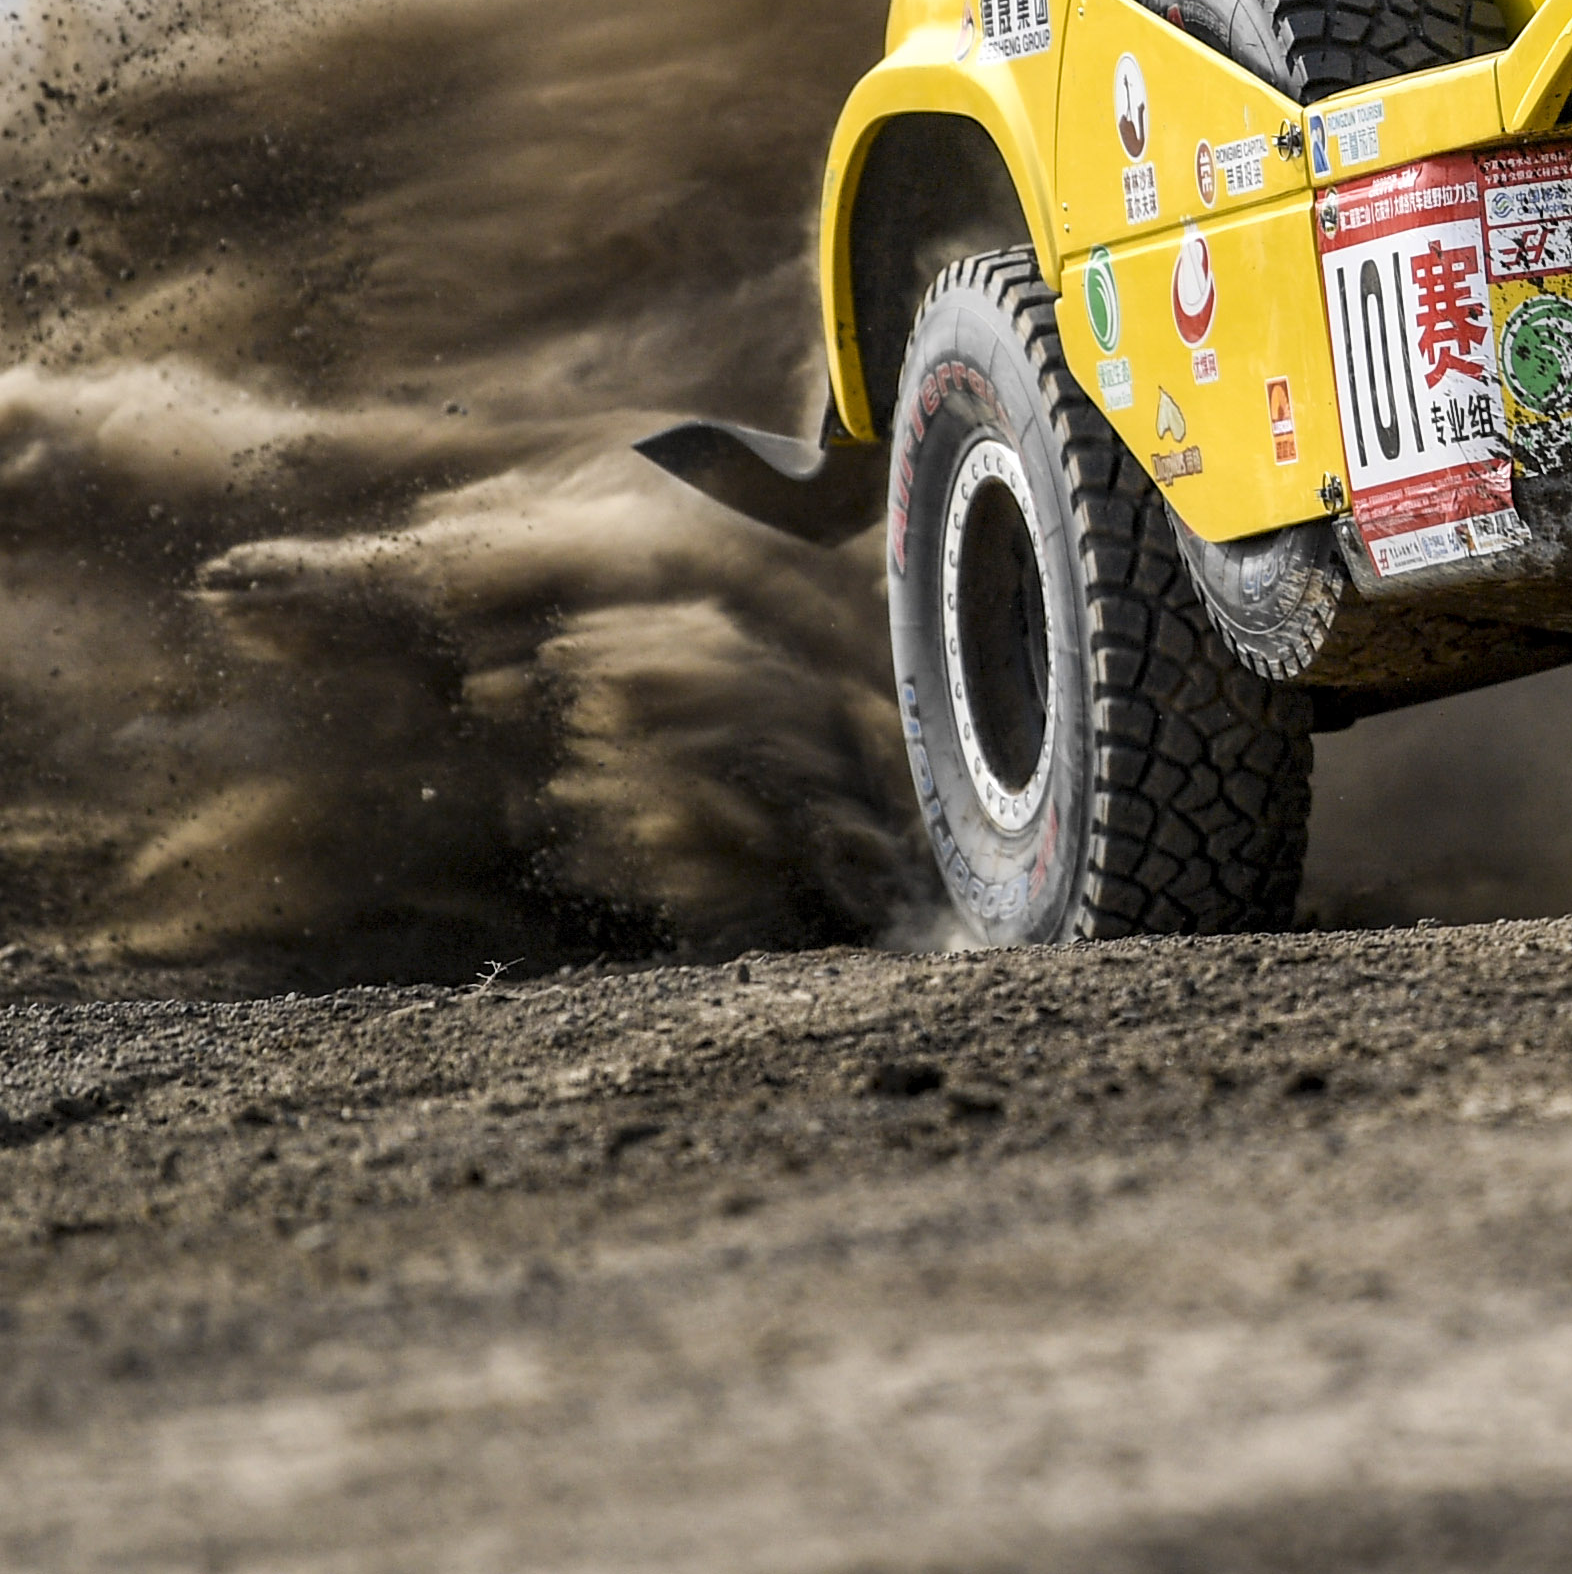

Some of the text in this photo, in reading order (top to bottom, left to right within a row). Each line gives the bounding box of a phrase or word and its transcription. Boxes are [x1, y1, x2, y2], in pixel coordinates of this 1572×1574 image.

[1022, 28, 1051, 52] GROUP
[1336, 250, 1425, 468] 101
[1410, 239, 1488, 390] 赛
[1429, 393, 1497, 447] 专业组
